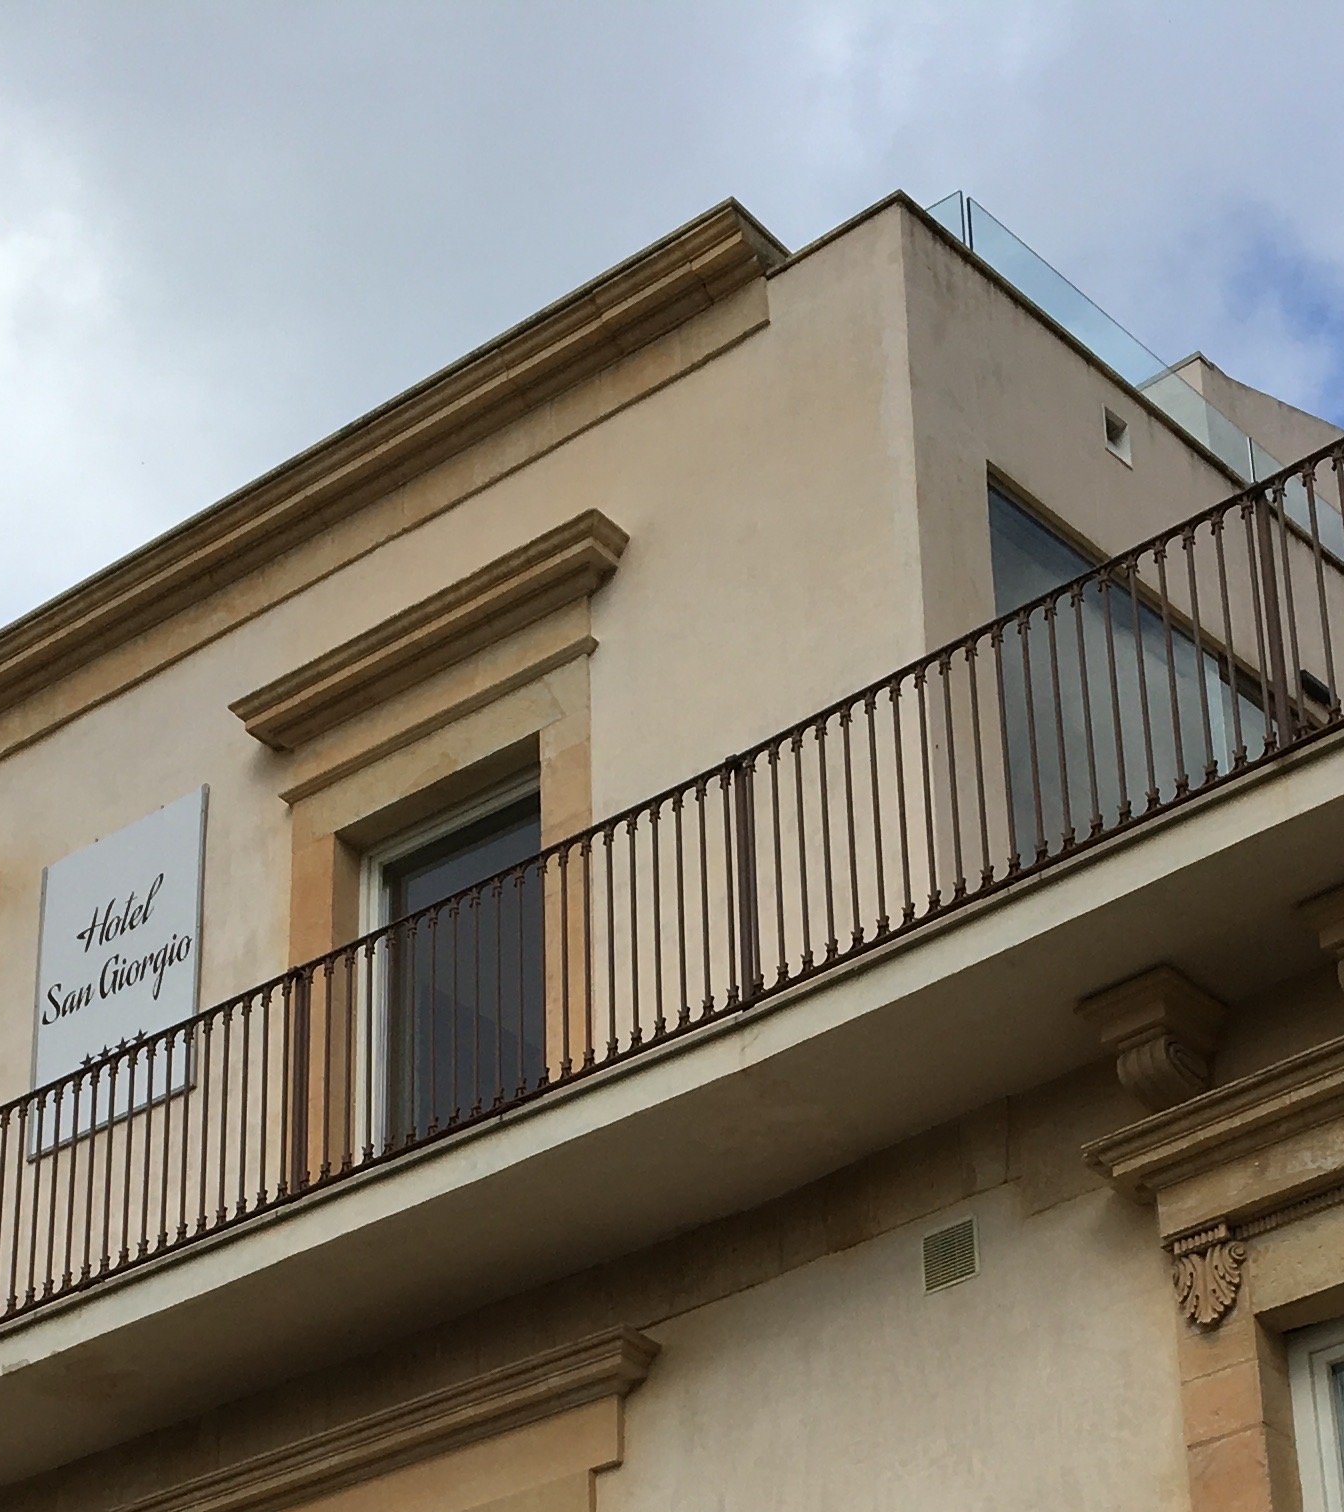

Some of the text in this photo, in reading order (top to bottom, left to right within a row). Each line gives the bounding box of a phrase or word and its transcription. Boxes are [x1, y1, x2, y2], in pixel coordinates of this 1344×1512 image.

[77, 873, 164, 953] Hotel
[42, 934, 192, 1026] San Giorgio
